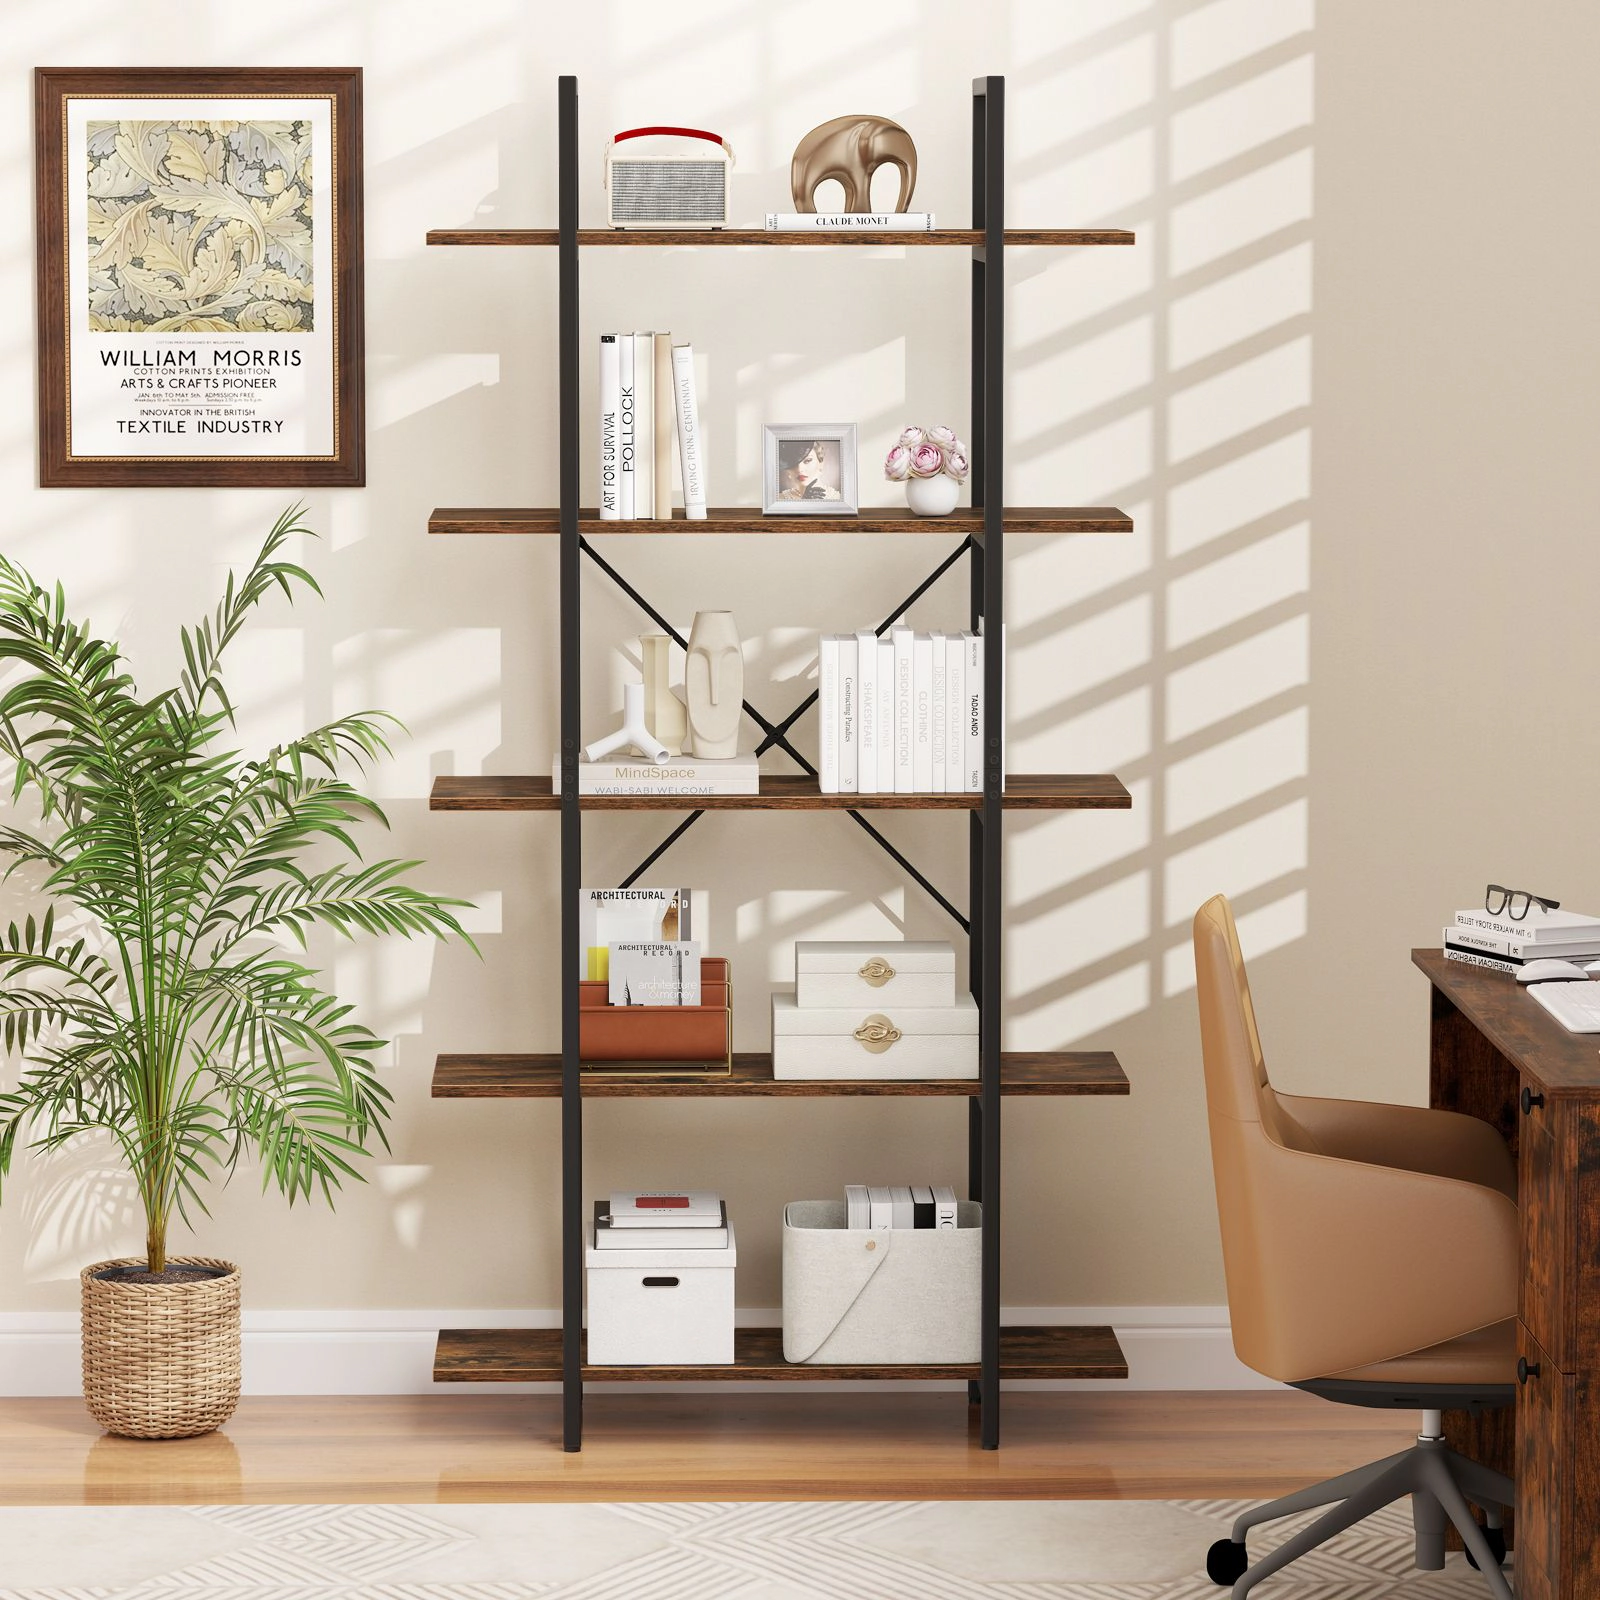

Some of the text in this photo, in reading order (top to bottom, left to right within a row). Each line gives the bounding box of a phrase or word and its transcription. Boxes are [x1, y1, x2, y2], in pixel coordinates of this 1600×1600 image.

[816, 216, 889, 226] CLAUDE MONET
[100, 350, 302, 367] WILLIAM MORRIS
[133, 368, 271, 376] COTTON PRINTS EXHIBITION
[120, 378, 277, 389] ARTS & CRAFTS PIONEER
[140, 409, 192, 417] INNOVATOR
[680, 378, 693, 433] CENTENNIAL
[117, 420, 284, 434] TEXTILE INDUSTRY
[621, 387, 634, 472] POLLOCK
[603, 412, 615, 511] ART FOR SURVIVAL
[688, 463, 699, 496] IRVING
[843, 677, 853, 716] Constructing
[899, 658, 909, 767] DESIGN COLLECTION
[863, 681, 873, 749] SHAKESPEARE
[918, 690, 929, 743] CLOTHING
[933, 666, 945, 765] DESIGN COLLECTION
[951, 668, 960, 766] DESIGN COLLECTION
[971, 694, 979, 737] TADAO ANDO
[595, 786, 715, 795] WABI-SABI WELCOME
[615, 767, 696, 781] MindSpace
[590, 891, 666, 901] ARCHITECTURAL
[638, 975, 698, 990] architecture
